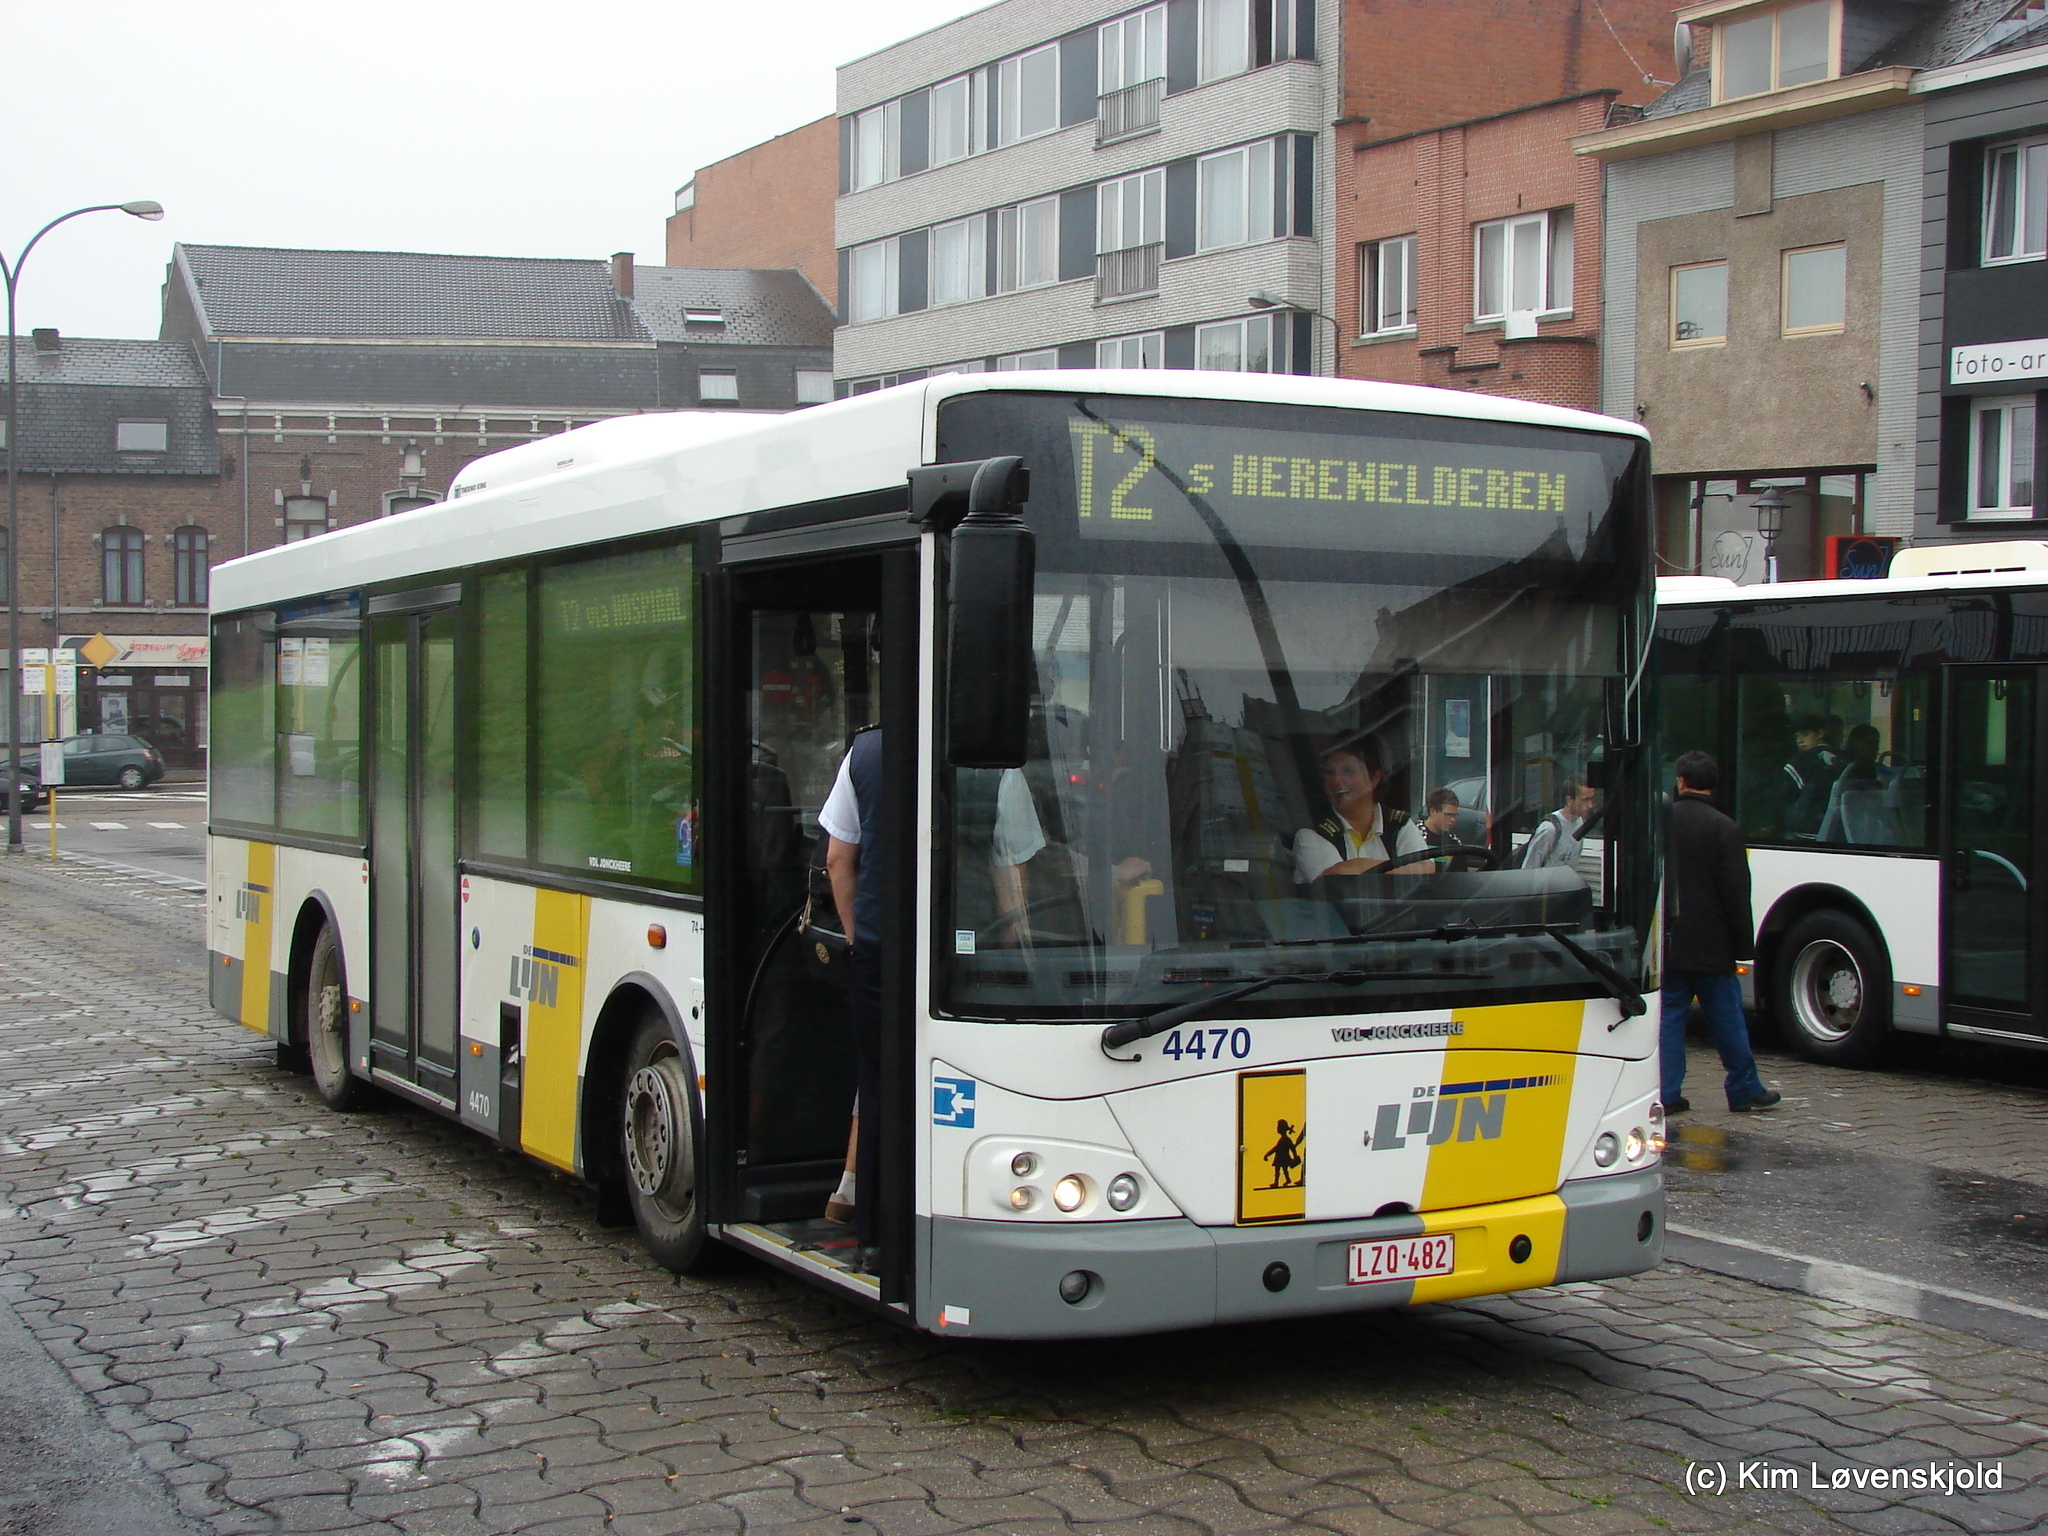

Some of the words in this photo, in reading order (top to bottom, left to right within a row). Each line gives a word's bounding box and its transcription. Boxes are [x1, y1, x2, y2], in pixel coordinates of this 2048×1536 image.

[1069, 420, 1155, 520] T2
[588, 856, 600, 868] VDL
[523, 944, 532, 956] DE
[509, 955, 559, 1008] LIJN
[1162, 1027, 1251, 1061] 4470
[1331, 1027, 1367, 1042] VDL
[1368, 1022, 1464, 1041] JONCKHEERE
[469, 1090, 490, 1118] 4470
[1412, 1085, 1437, 1099] DE
[1371, 1093, 1507, 1151] LIJN
